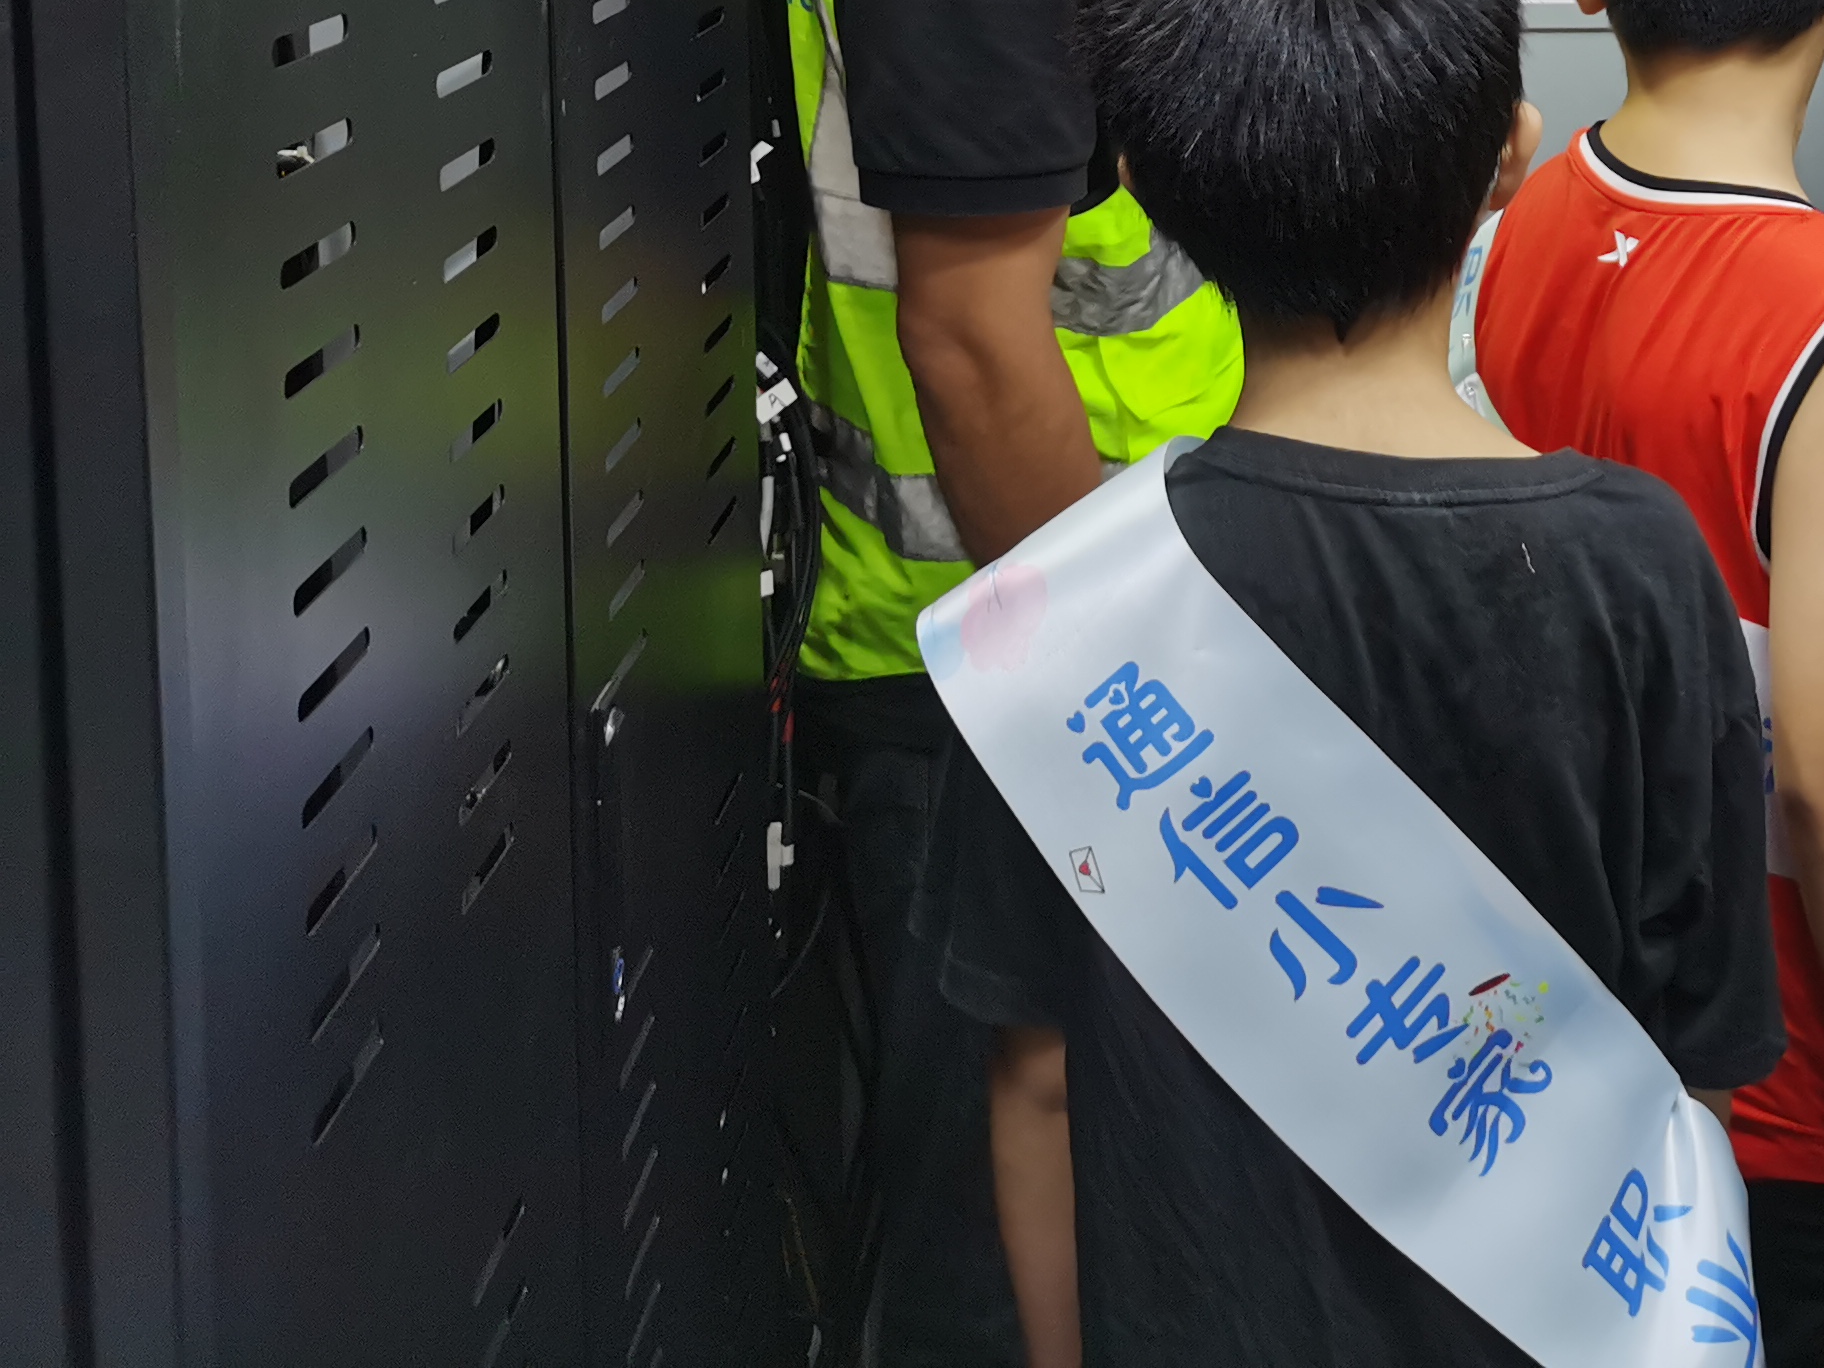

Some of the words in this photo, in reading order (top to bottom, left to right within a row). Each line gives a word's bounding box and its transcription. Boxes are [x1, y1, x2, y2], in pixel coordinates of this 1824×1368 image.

[1066, 660, 1553, 1177] 通信小专家
